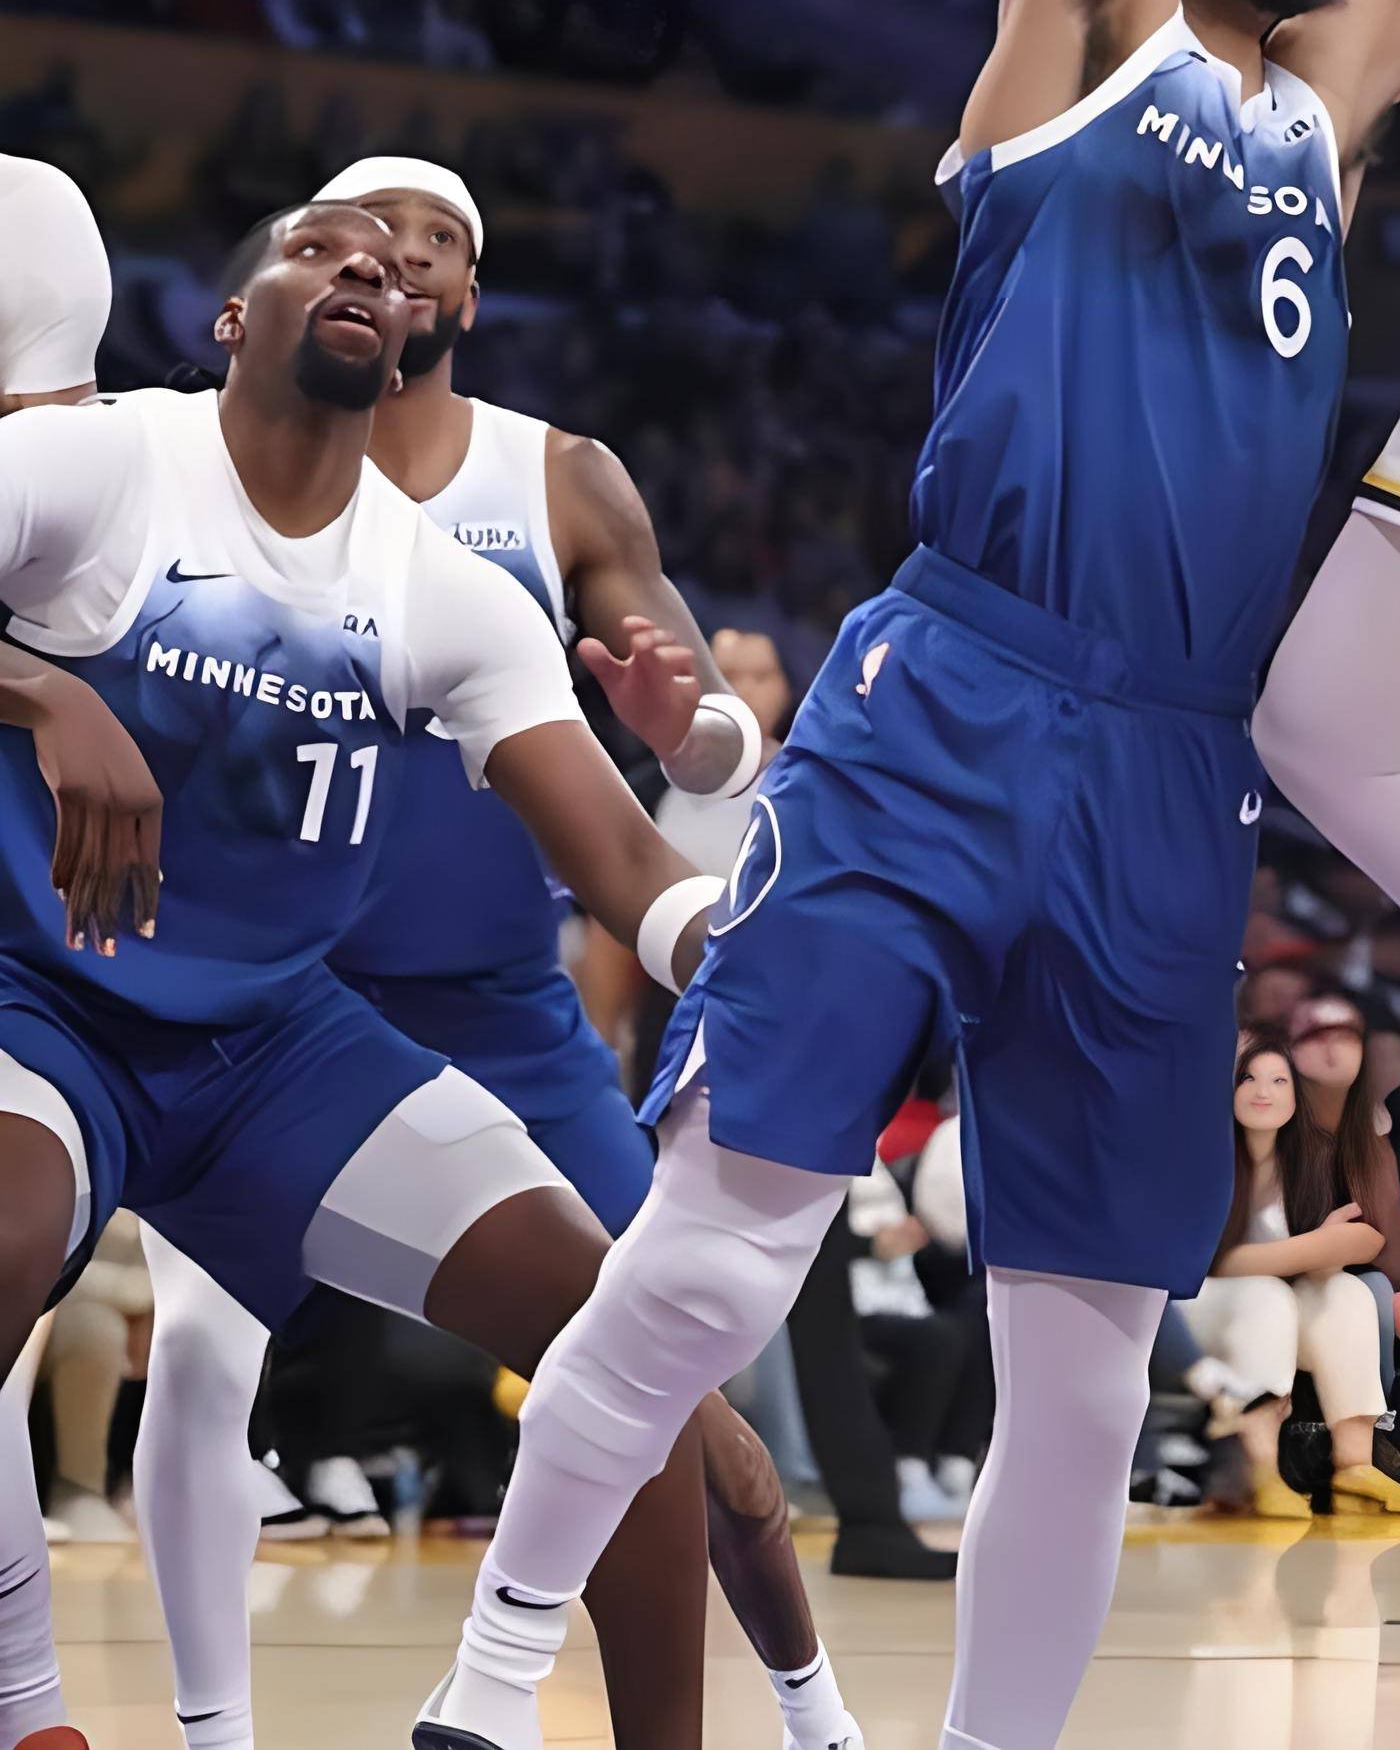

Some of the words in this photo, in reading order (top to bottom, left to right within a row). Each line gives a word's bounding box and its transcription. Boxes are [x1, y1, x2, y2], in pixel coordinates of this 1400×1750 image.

[1136, 104, 1333, 237] MINNSOA
[1261, 236, 1314, 359] 6
[296, 742, 379, 846] 11
